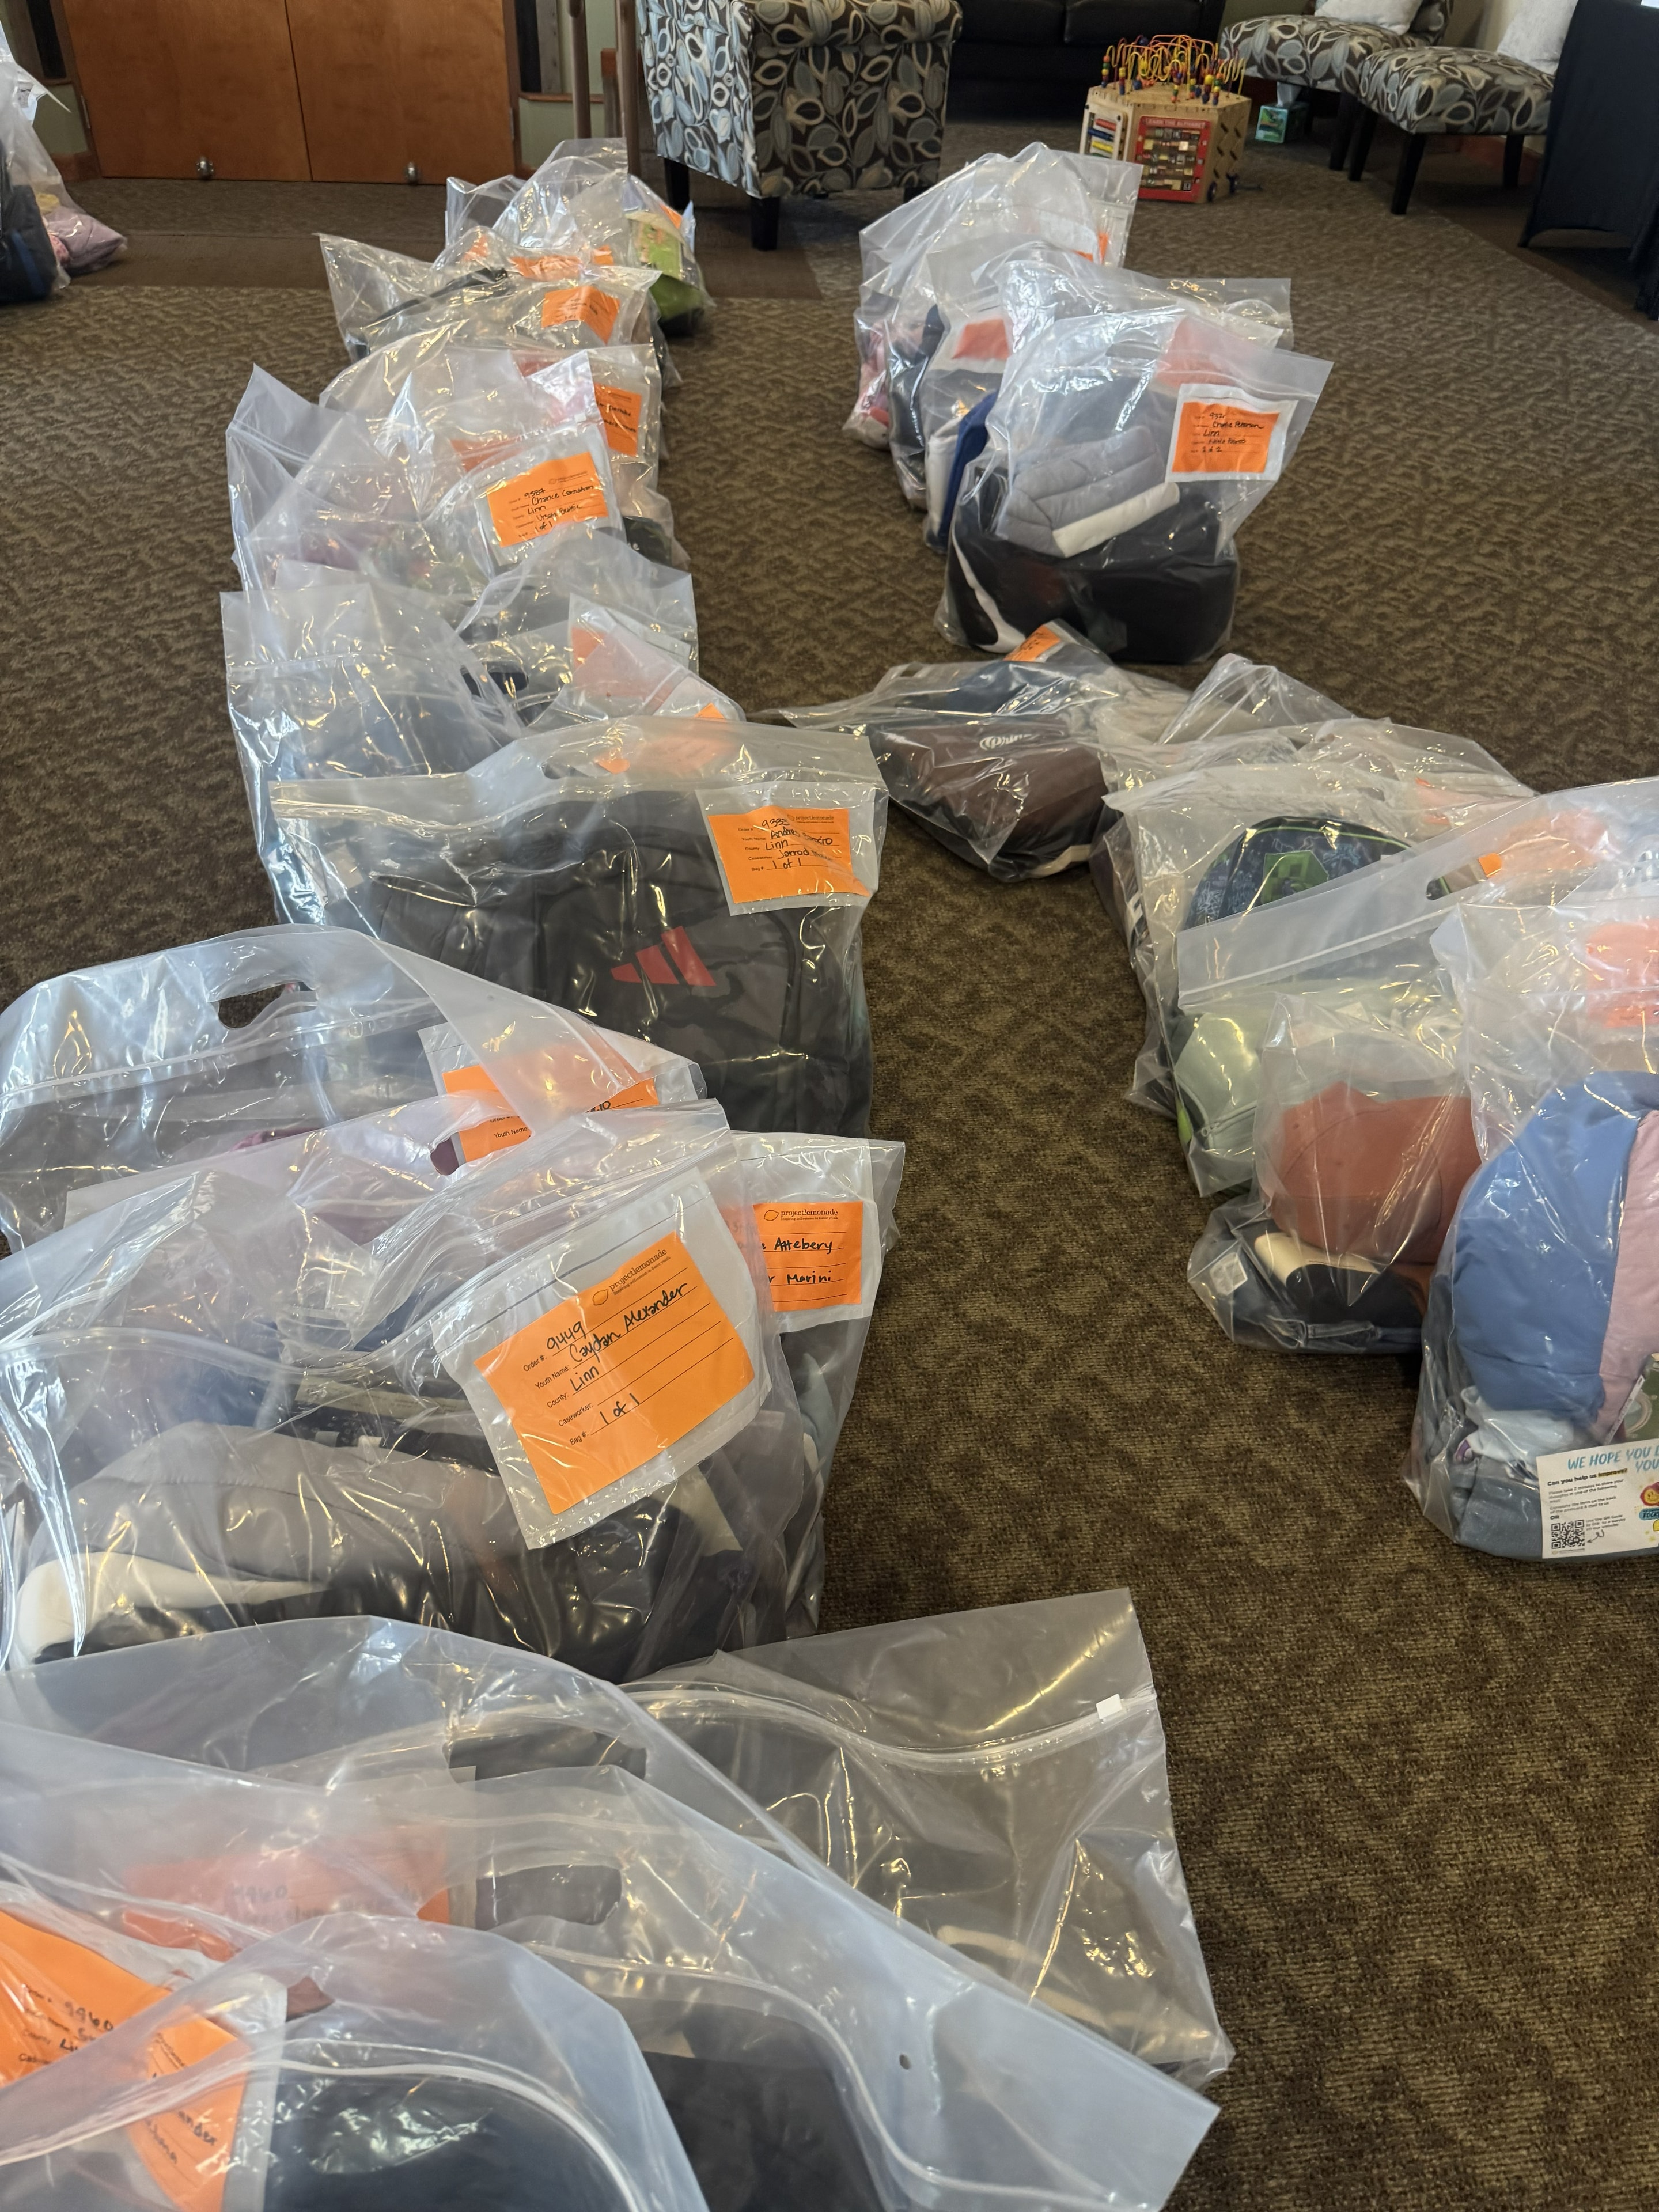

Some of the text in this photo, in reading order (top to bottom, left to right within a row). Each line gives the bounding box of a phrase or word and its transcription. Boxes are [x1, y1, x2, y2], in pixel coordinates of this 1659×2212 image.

[527, 505, 547, 514] Linn
[766, 839, 789, 850] Linn
[772, 858, 801, 869] 1 of 1
[781, 1209, 838, 1217] projectlemonade
[774, 1237, 832, 1255] Attebery
[609, 1249, 667, 1292] projectlemonade
[787, 1270, 832, 1285] Marini
[623, 1282, 688, 1332] Alexander
[547, 1321, 587, 1350] 9449
[523, 1358, 540, 1372] Order
[535, 1377, 552, 1389] Youth
[570, 1365, 600, 1392] Linn
[599, 1392, 640, 1425] 1 of 1
[570, 1434, 583, 1446] Bag
[1567, 1456, 1586, 1470] WE
[1588, 1450, 1623, 1467] HOPE
[1626, 1446, 1652, 1461] YOU
[1597, 1468, 1627, 1477] improve?
